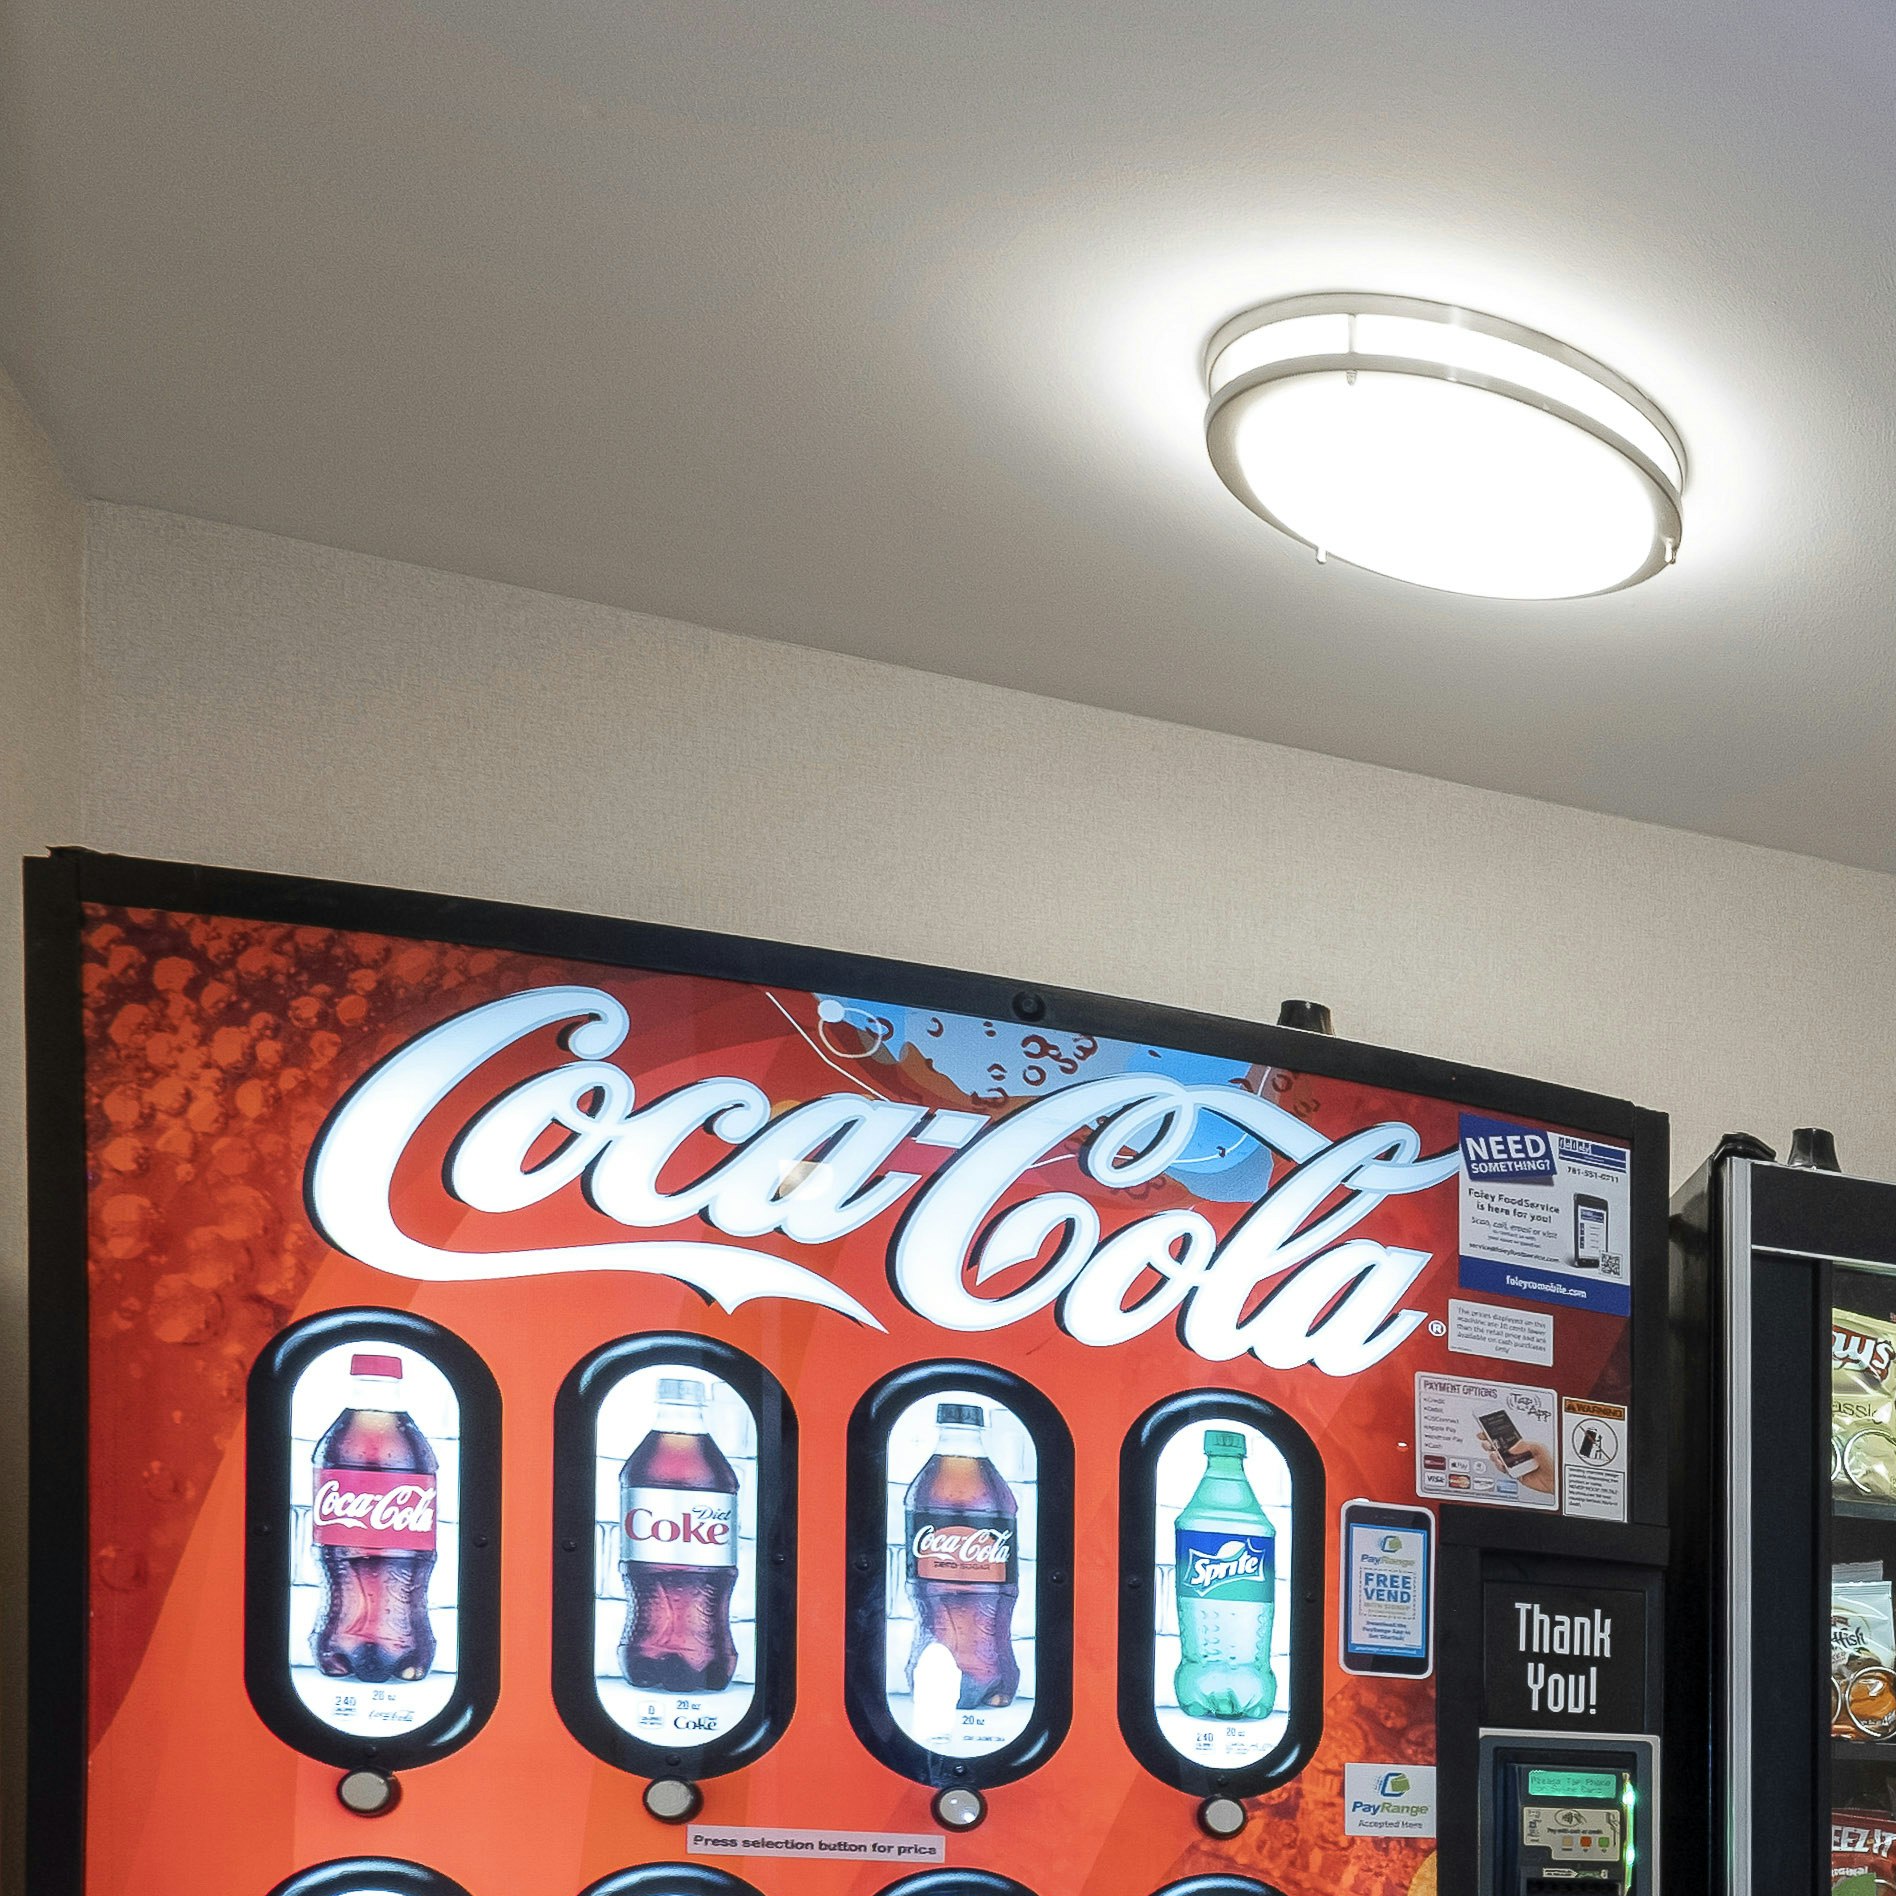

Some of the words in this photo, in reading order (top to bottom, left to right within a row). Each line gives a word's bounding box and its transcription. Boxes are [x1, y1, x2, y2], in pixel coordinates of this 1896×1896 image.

[1465, 1134, 1546, 1161] NEED
[1471, 1159, 1550, 1174] SOMETHING?
[305, 985, 1459, 1377] Coca-Cola
[1462, 1385, 1498, 1399] OPTIONS
[312, 1479, 434, 1532] Coca-Cola
[625, 1507, 730, 1546] Coke
[912, 1524, 1013, 1563] Coca-Cola
[1190, 1553, 1260, 1588] Sprite
[1364, 1572, 1412, 1590] FREE
[1364, 1587, 1412, 1604] VEND
[1514, 1602, 1612, 1659] Thank
[1526, 1662, 1598, 1715] You!
[962, 1715, 974, 1726] 20
[1352, 1801, 1429, 1817] PayRange
[693, 1834, 738, 1848] Press
[742, 1837, 814, 1851] selection
[818, 1840, 867, 1852] button
[871, 1843, 894, 1853] for
[897, 1844, 937, 1856] price
